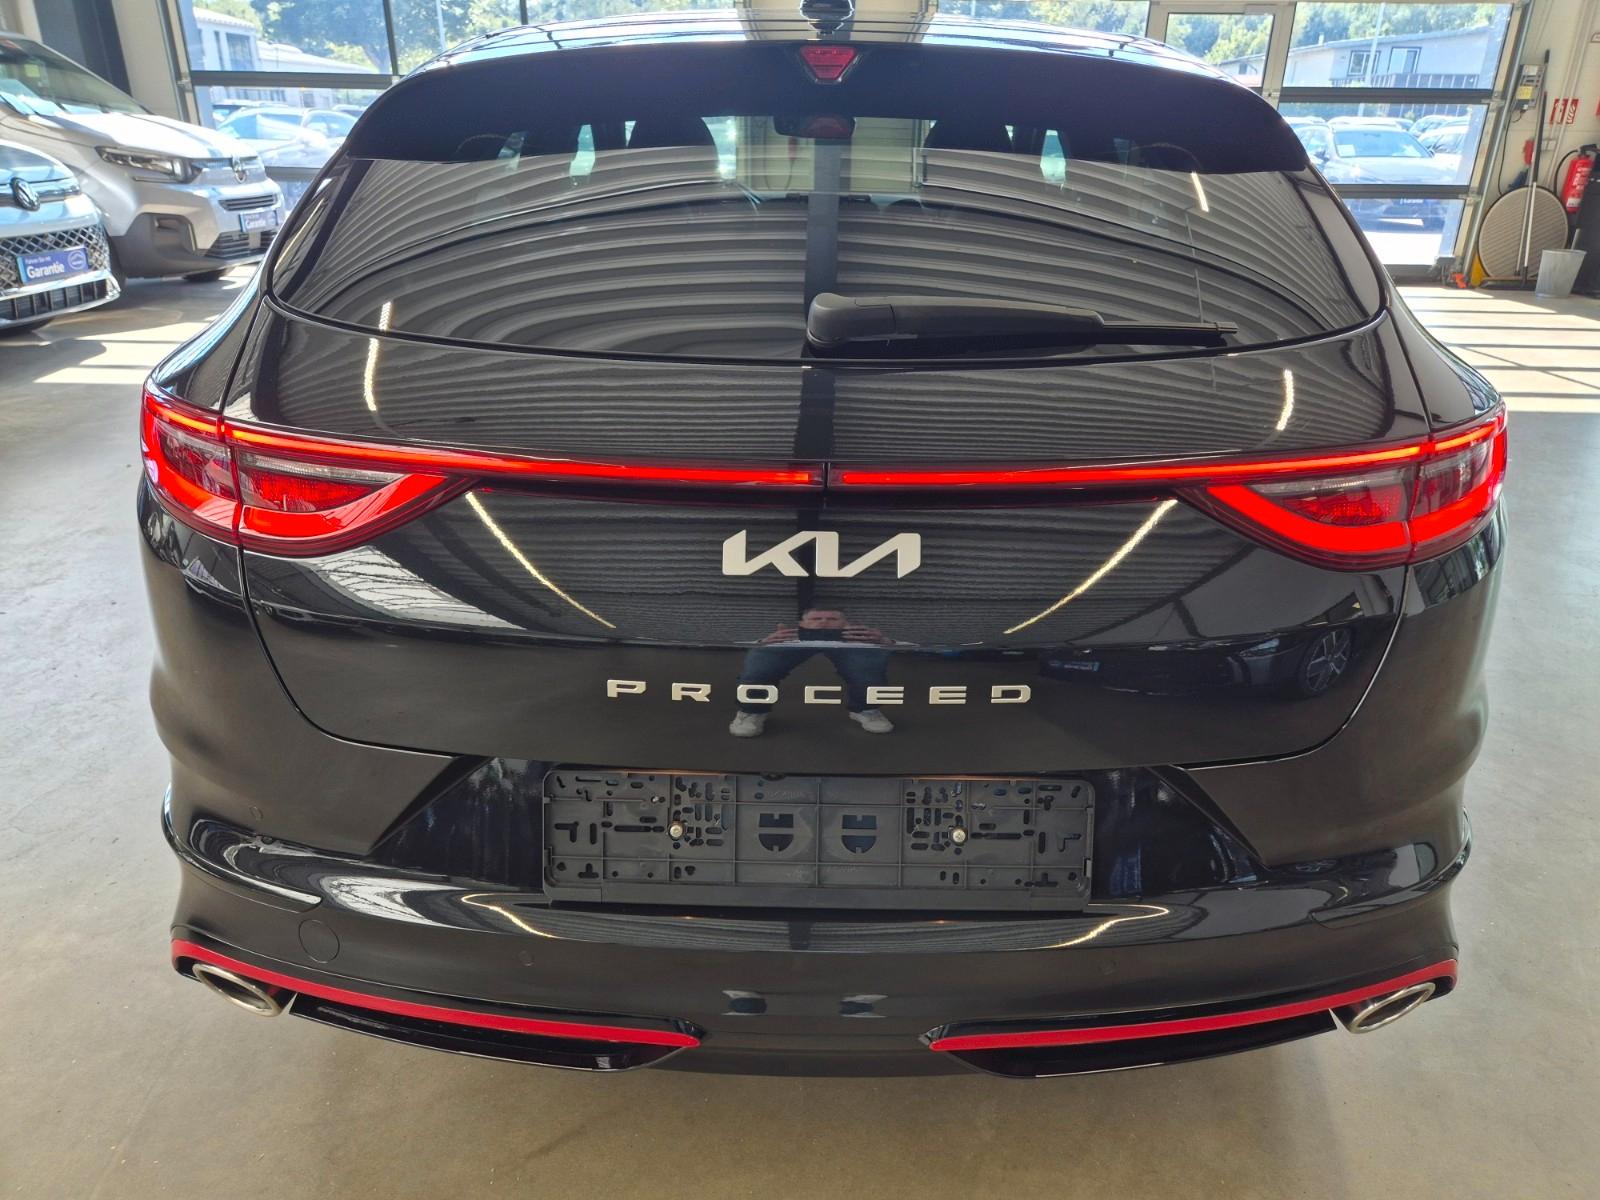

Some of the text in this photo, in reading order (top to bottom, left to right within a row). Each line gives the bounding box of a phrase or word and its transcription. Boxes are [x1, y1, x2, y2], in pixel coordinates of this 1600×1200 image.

[27, 261, 65, 278] Garantie
[722, 529, 921, 579] KIA
[607, 679, 1032, 706] PROCEED
